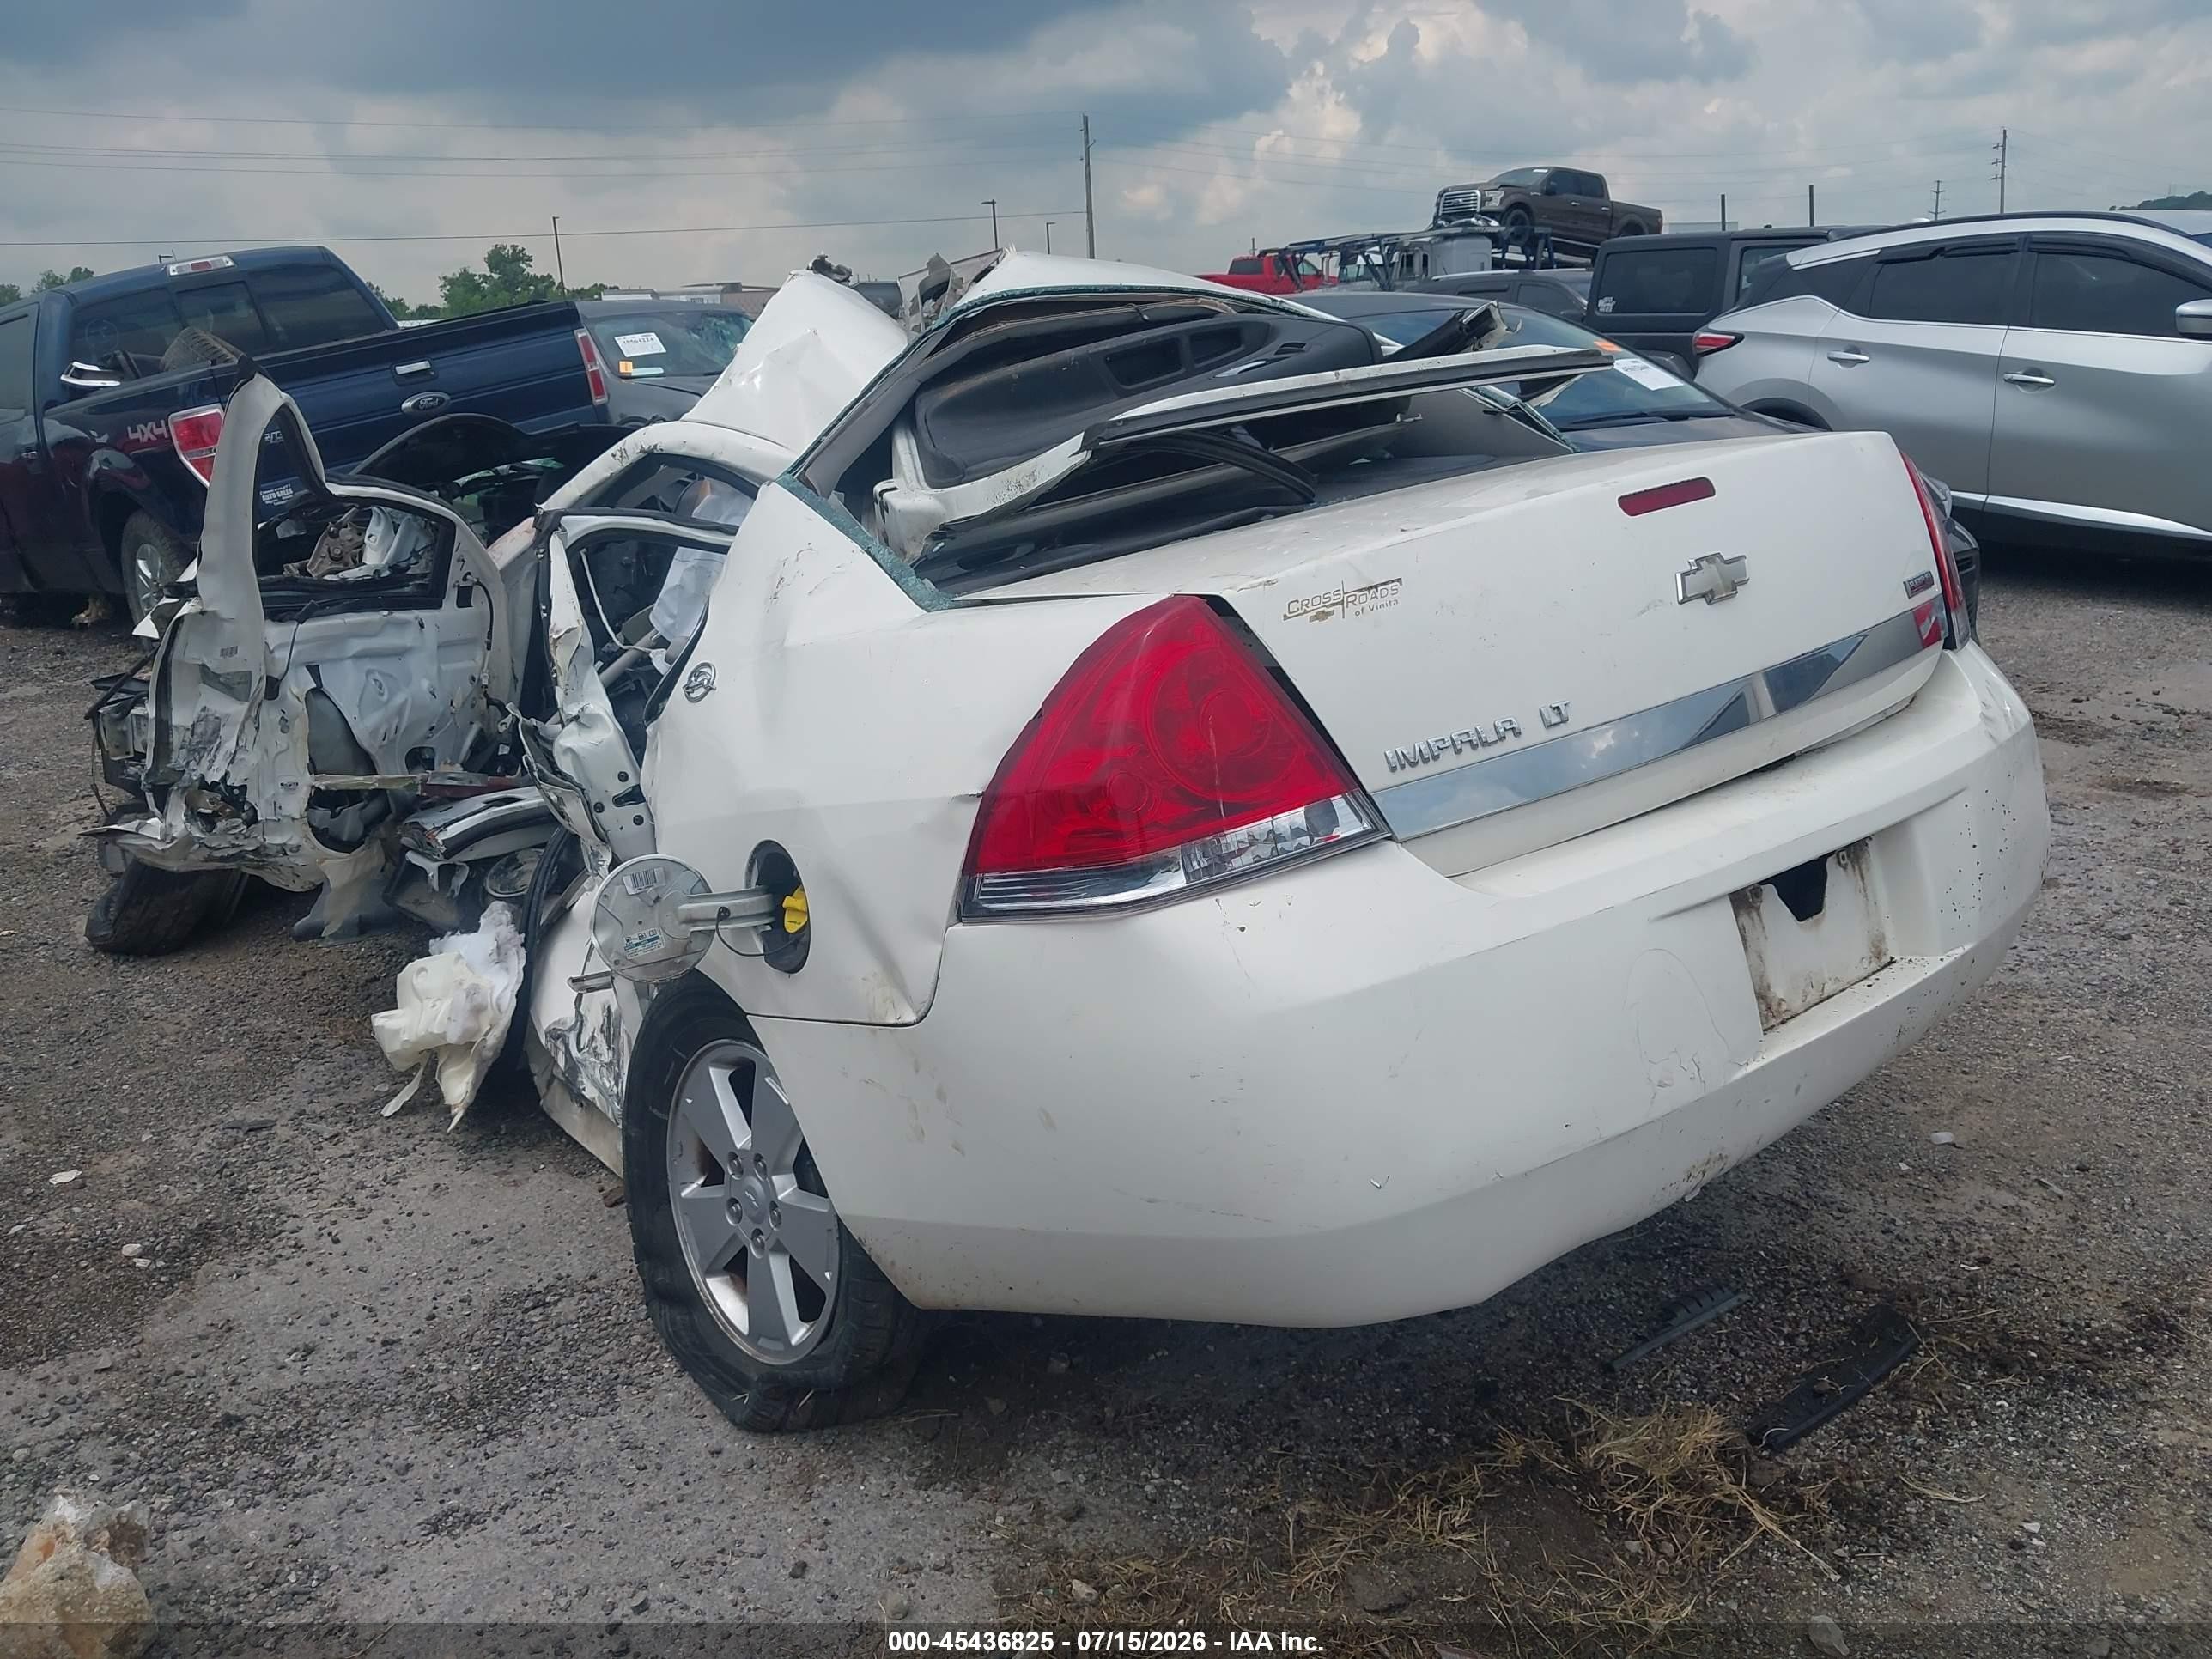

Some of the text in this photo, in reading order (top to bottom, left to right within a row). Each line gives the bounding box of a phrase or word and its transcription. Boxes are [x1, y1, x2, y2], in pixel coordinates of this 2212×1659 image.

[418, 397, 439, 410] Ford
[1354, 606, 1364, 617] of
[1384, 700, 1571, 772] IMPALA LT
